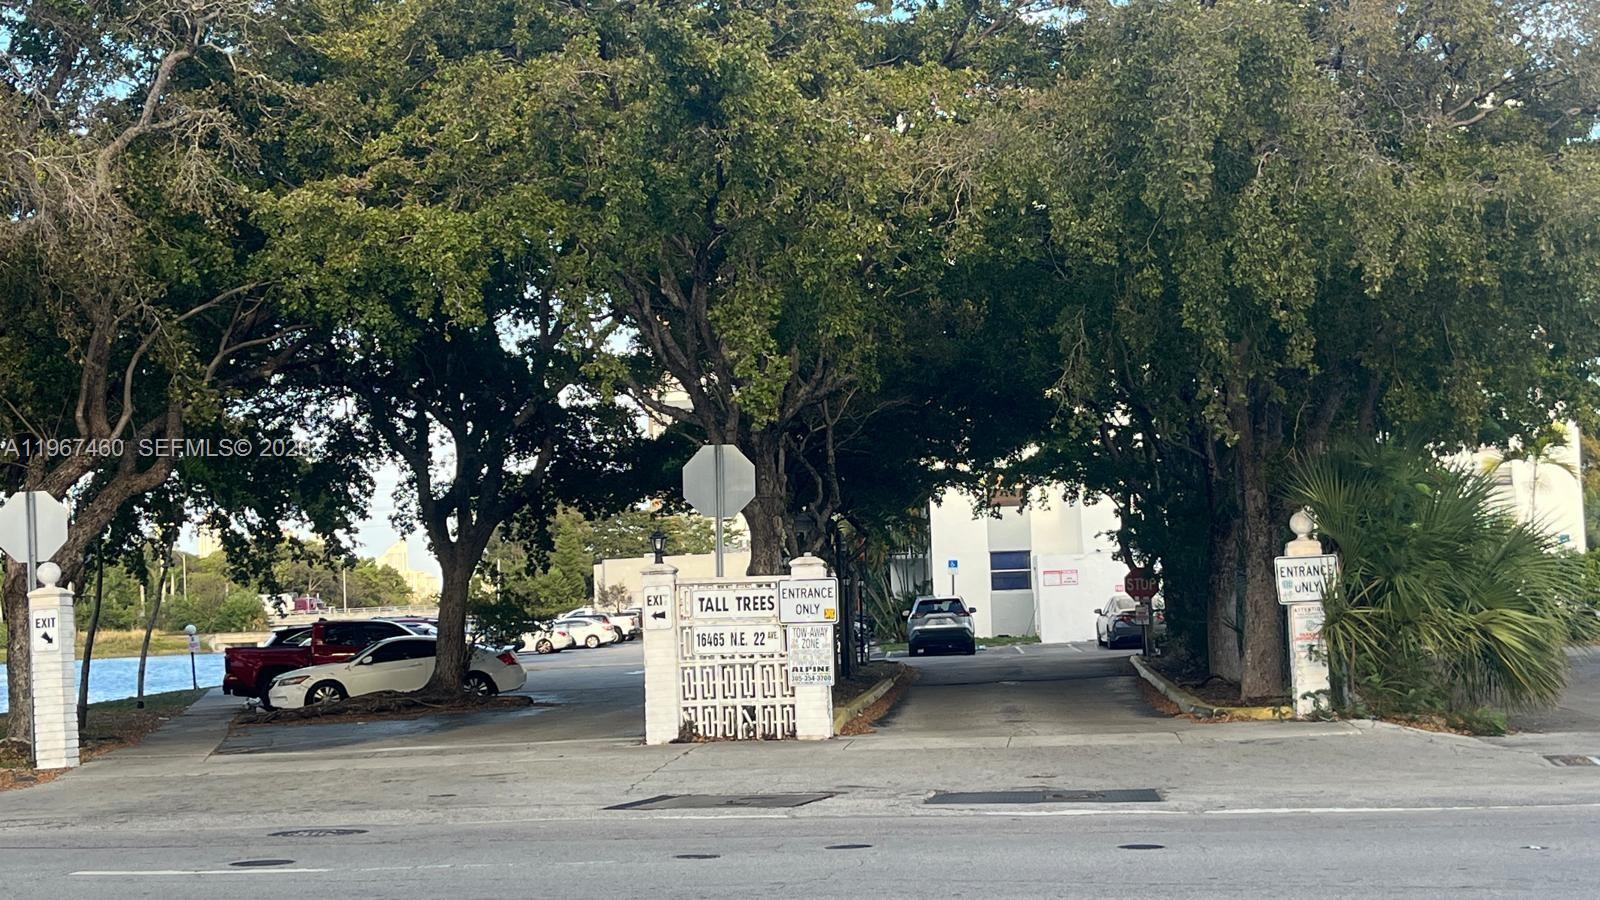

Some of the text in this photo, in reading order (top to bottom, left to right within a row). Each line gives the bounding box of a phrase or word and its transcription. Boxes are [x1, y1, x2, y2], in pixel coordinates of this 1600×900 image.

[1126, 578, 1157, 592] STOP
[1295, 580, 1321, 593] ONLY
[782, 587, 834, 600] ENTRANCE
[698, 595, 775, 613] TALL TREES
[795, 603, 820, 615] ONLY
[35, 617, 56, 629] EXIT
[696, 632, 725, 647] 16465
[753, 631, 766, 646] 22
[792, 627, 828, 638] TOW-AWAY
[801, 638, 820, 649] ZONE
